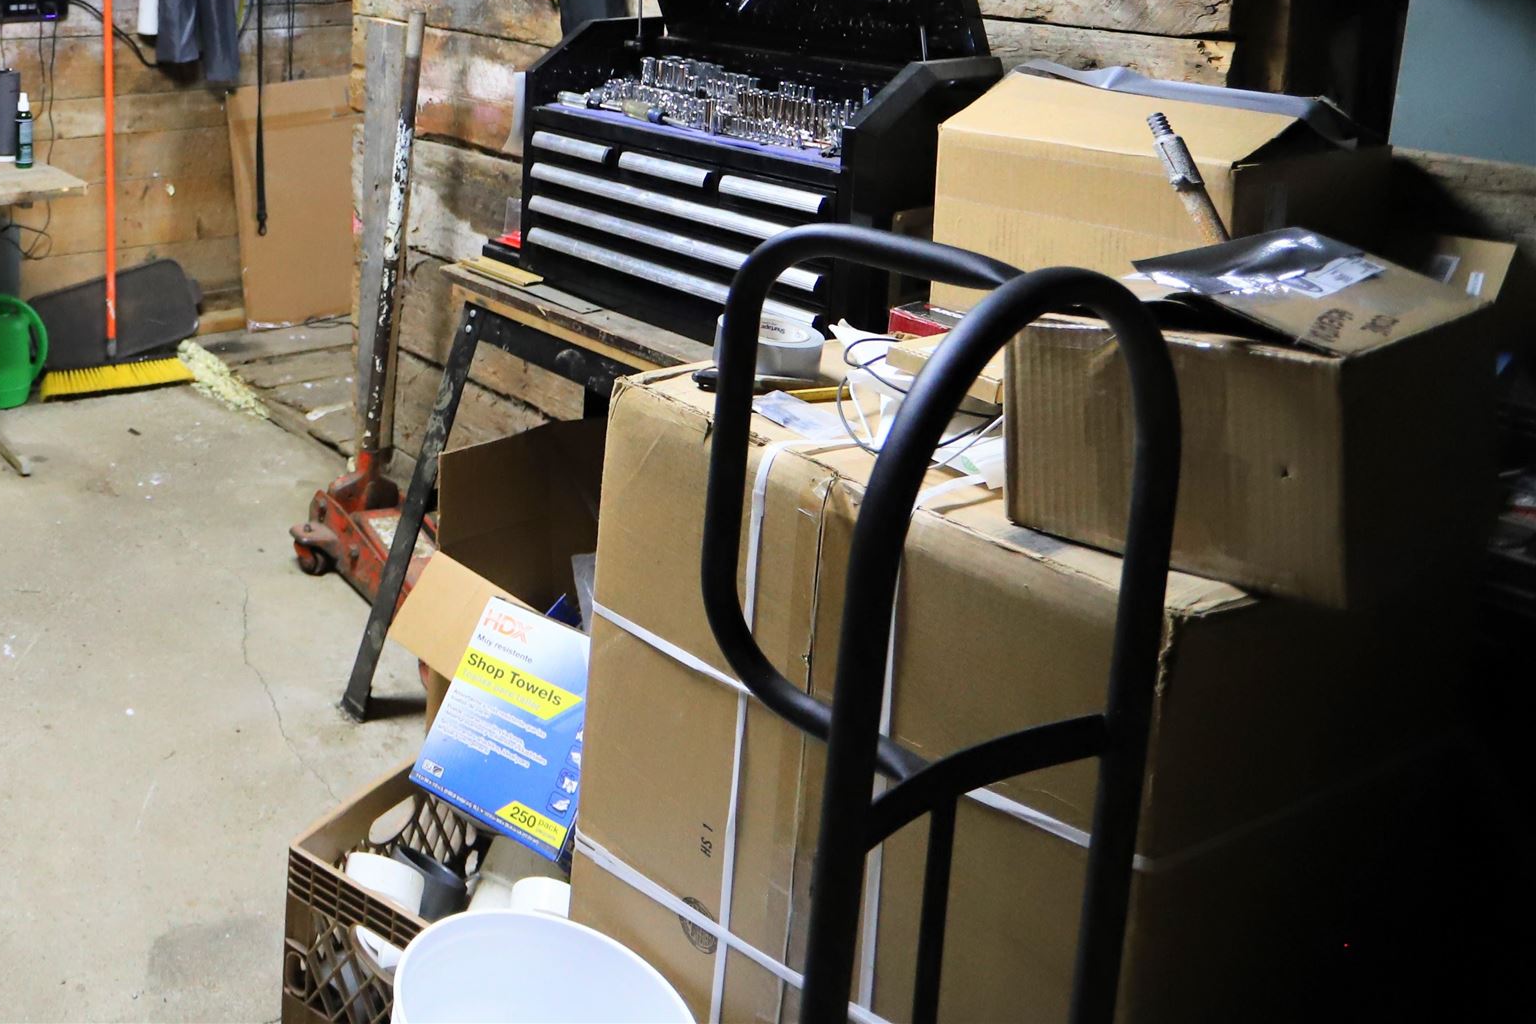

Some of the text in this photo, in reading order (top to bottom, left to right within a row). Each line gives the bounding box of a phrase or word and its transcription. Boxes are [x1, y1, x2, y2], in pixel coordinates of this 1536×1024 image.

[482, 607, 534, 644] HDX
[466, 652, 563, 707] Shop Towels
[509, 805, 537, 829] 250
[537, 817, 560, 835] pack
